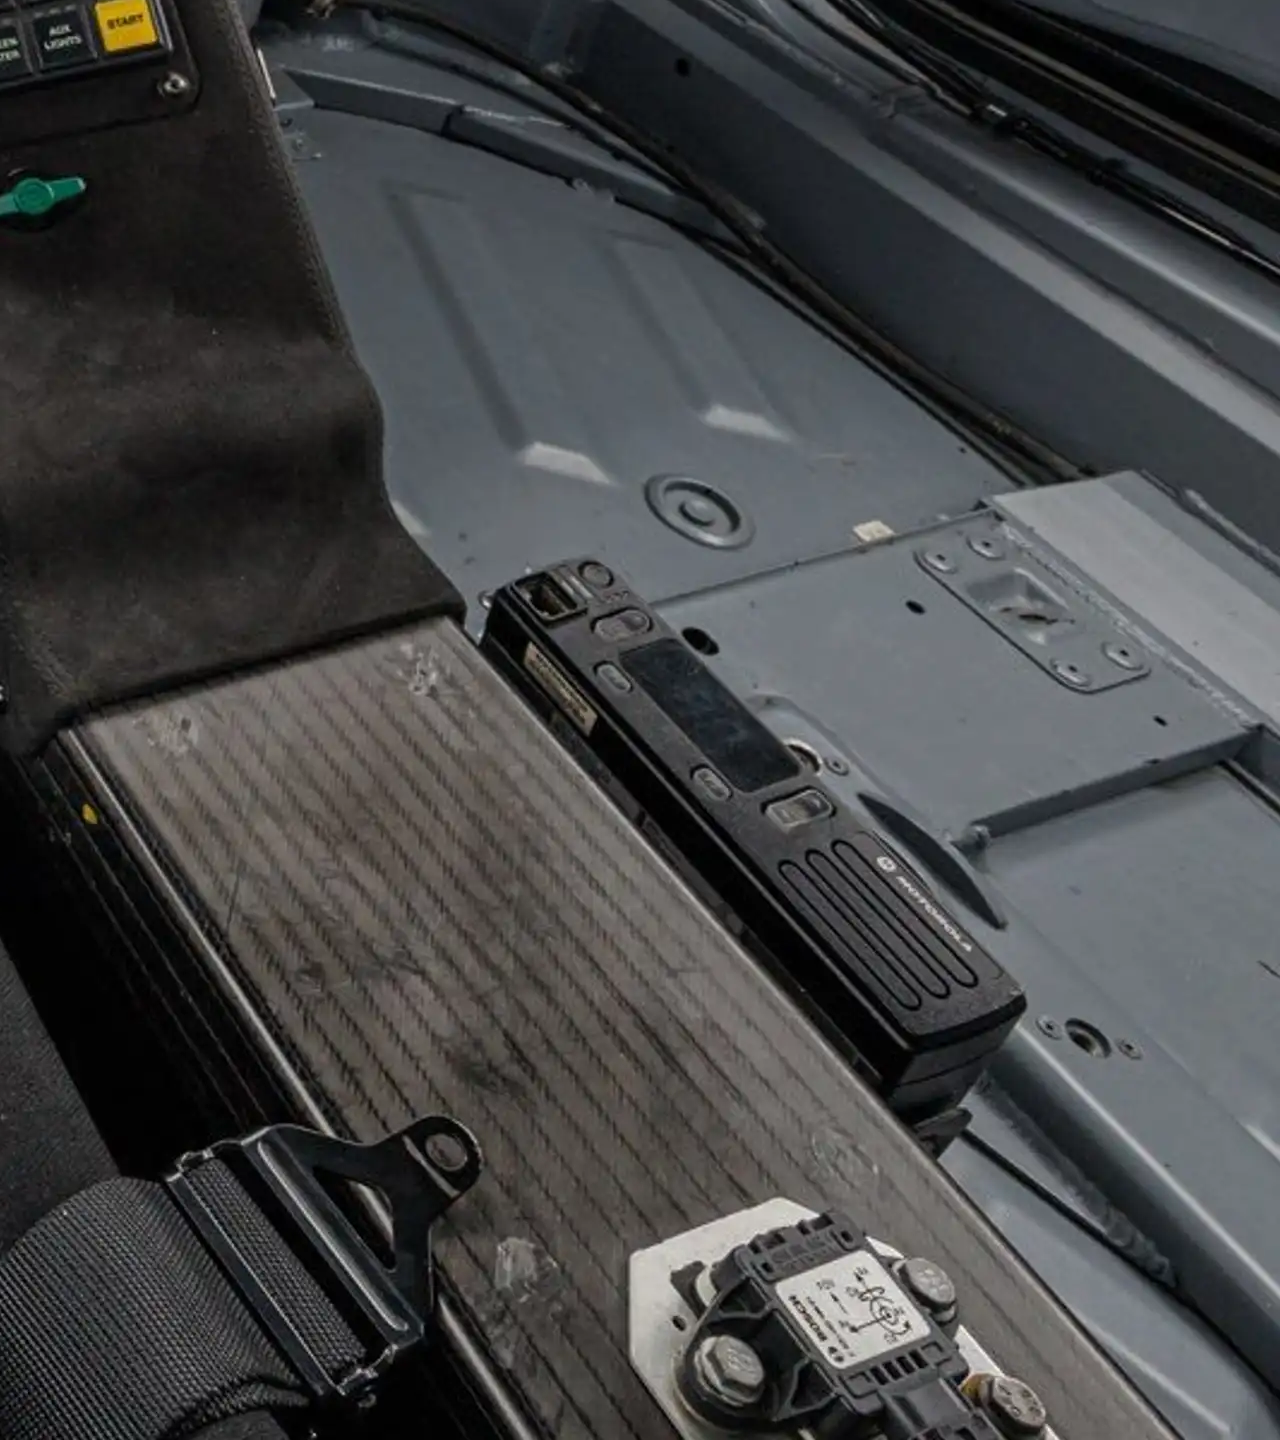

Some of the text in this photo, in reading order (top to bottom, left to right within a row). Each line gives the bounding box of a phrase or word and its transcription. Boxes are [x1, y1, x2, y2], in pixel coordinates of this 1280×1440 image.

[48, 23, 73, 37] AUX
[106, 13, 144, 30] START
[43, 35, 83, 52] LIGHTS
